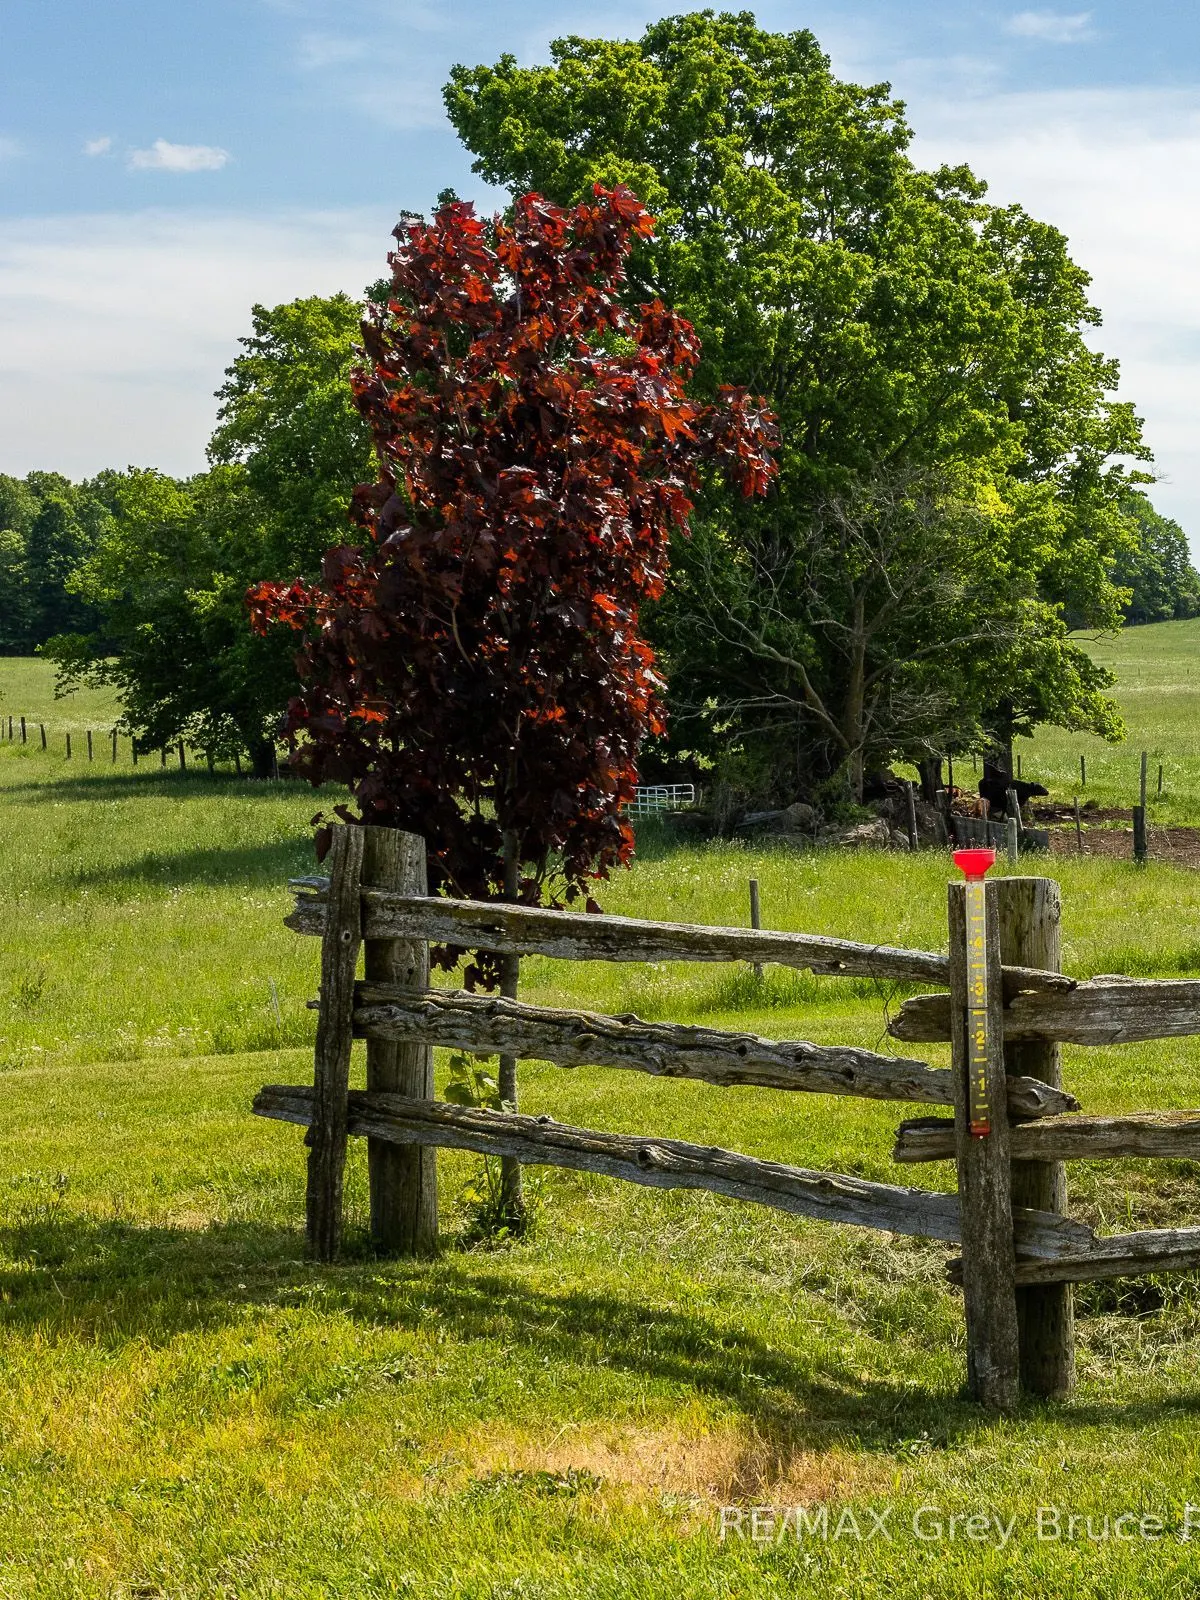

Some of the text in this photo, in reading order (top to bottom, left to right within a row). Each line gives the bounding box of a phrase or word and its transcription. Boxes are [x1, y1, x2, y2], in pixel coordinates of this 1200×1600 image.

[975, 982, 984, 996] 3
[976, 1031, 985, 1044] 2
[978, 1077, 985, 1090] 1
